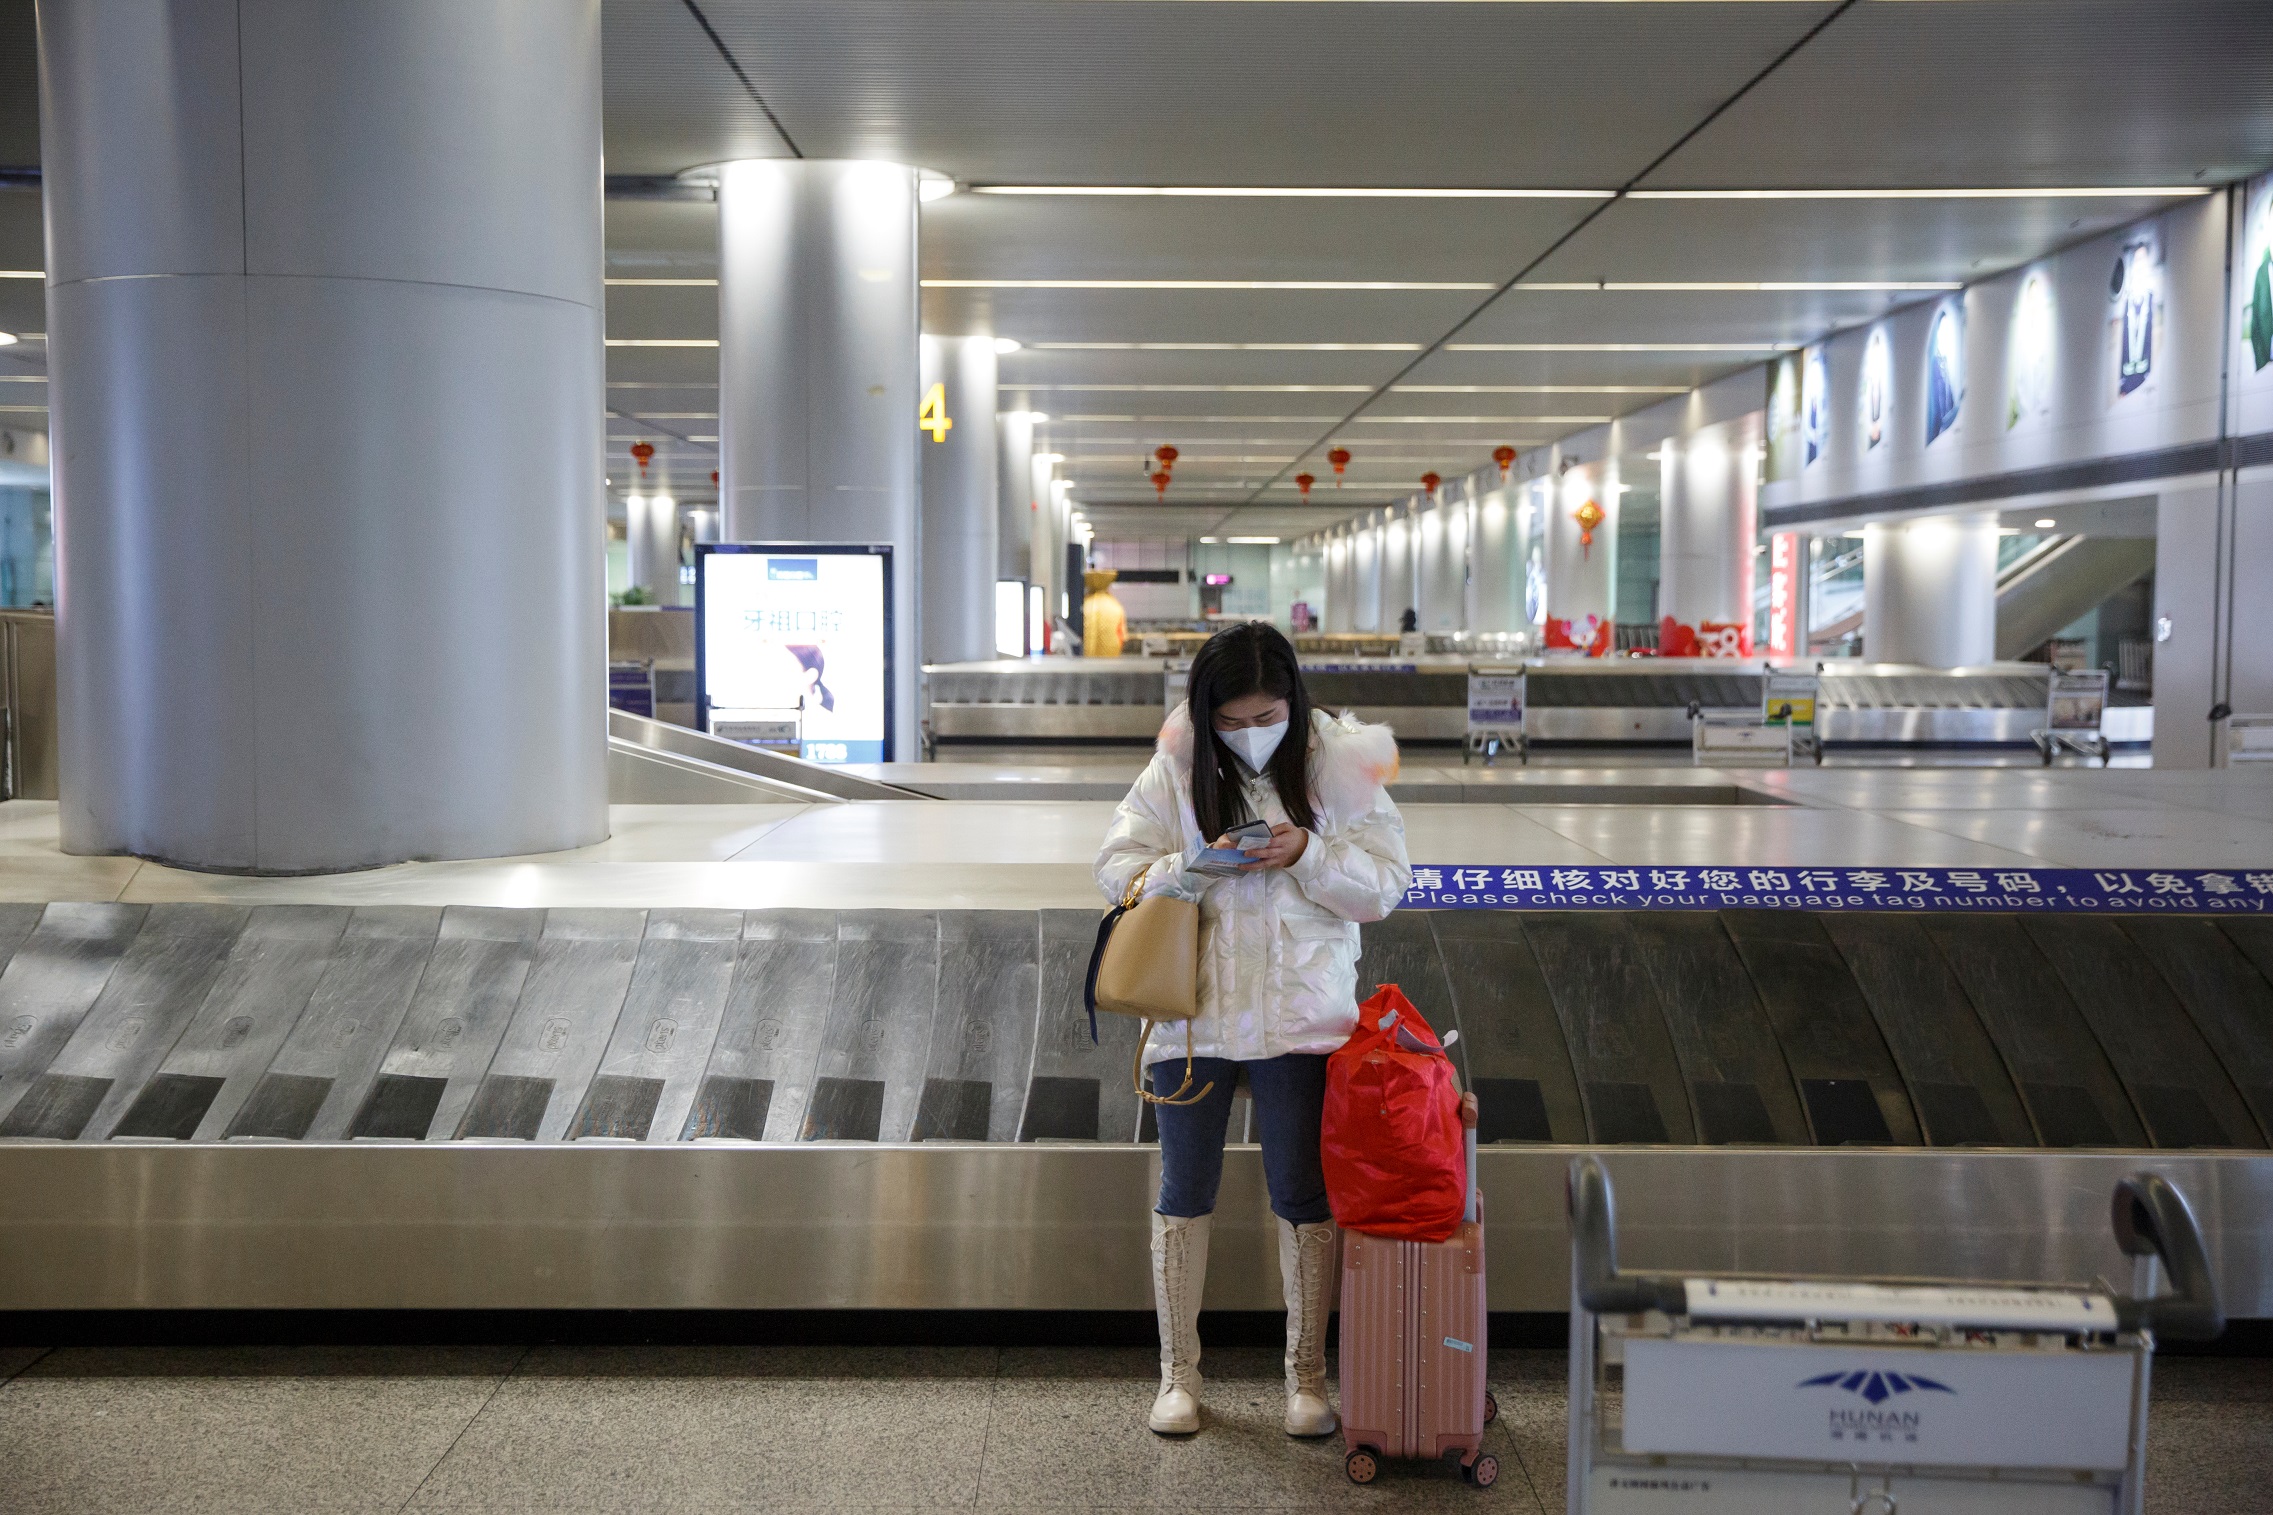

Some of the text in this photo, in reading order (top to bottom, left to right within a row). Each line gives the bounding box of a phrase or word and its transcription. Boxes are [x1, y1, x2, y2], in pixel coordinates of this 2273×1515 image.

[919, 383, 952, 443] 4
[1407, 891, 2265, 911] Please check your baggage tag number to avoid any
[1829, 1408, 1920, 1427] HUNAN
